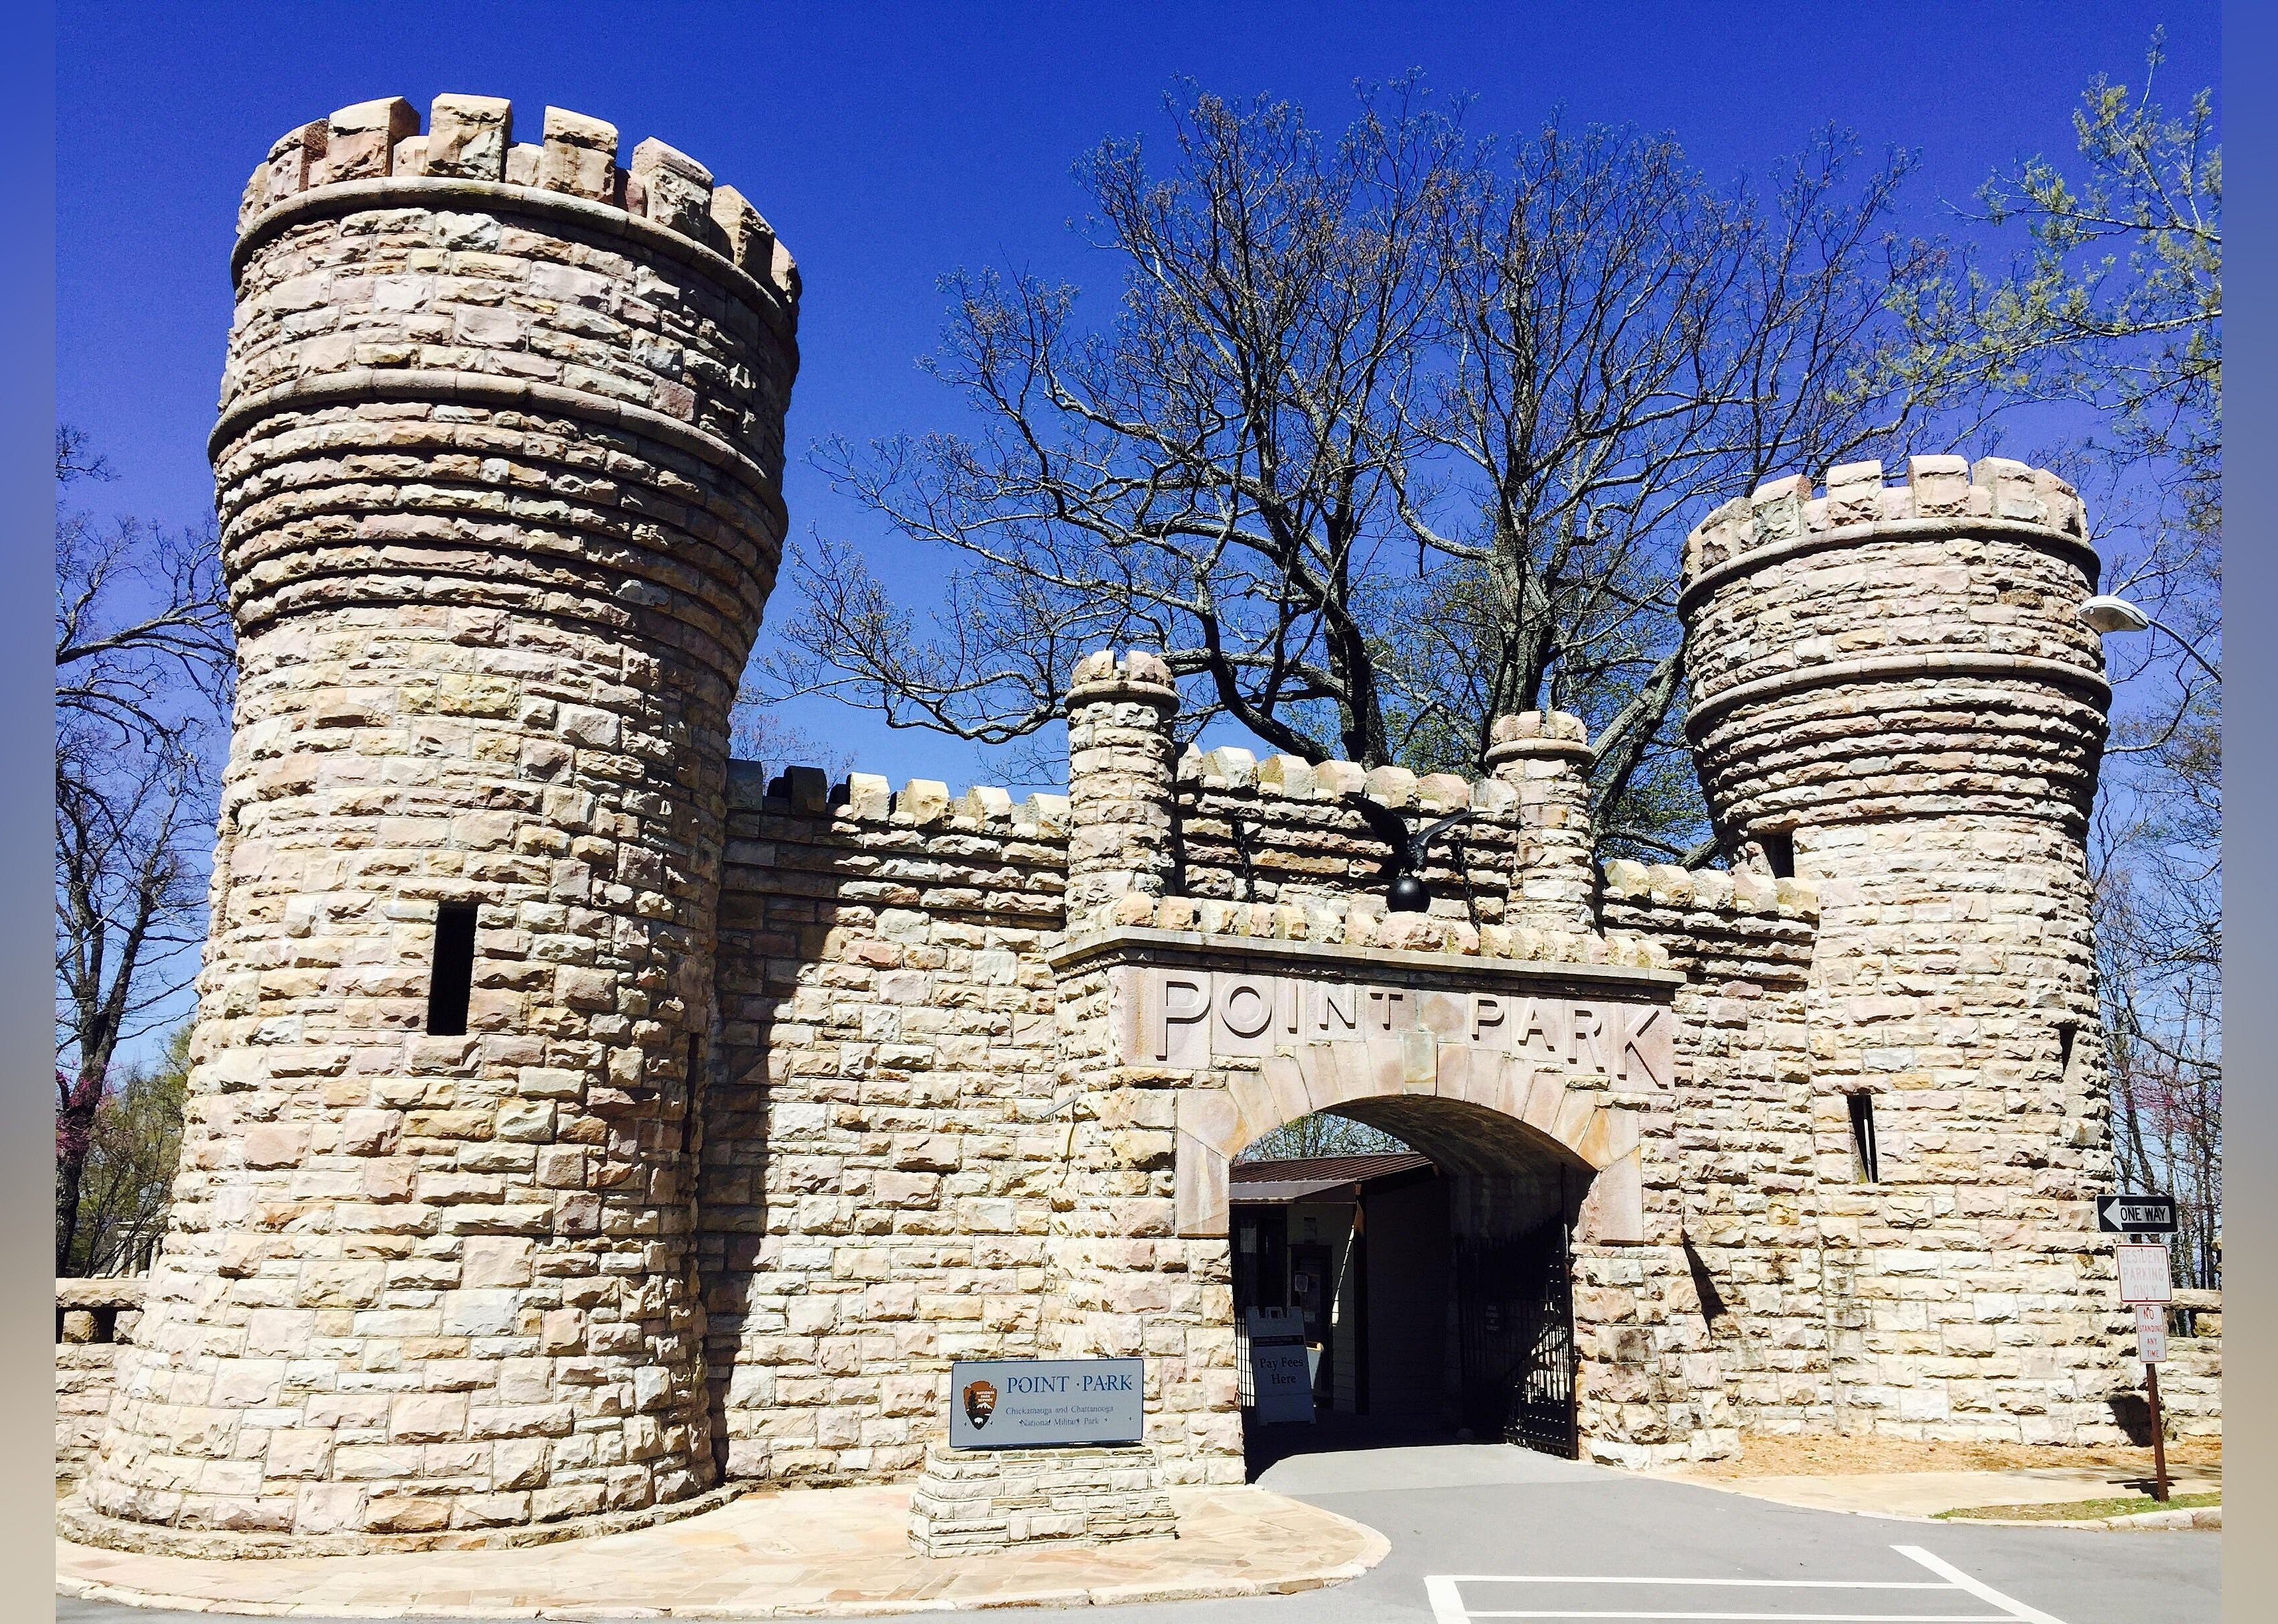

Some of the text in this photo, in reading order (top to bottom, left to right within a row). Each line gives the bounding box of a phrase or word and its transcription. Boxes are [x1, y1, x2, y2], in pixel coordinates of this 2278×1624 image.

[1156, 973, 1670, 1090] POINT PARK
[2120, 1206, 2167, 1221] ONE WAY
[2119, 1250, 2165, 1264] RESIDENT
[2123, 1267, 2164, 1282] PARKING
[2133, 1284, 2157, 1298] ONLY
[2143, 1308, 2155, 1320] NO
[2147, 1349, 2160, 1358] TIME
[1259, 1357, 1304, 1371] Pay Fees
[1006, 1374, 1133, 1394] POINT PARK
[1271, 1373, 1297, 1385] Here
[1005, 1406, 1052, 1416] Chickamauga
[1071, 1405, 1114, 1414] Chattanooga
[1021, 1418, 1051, 1427] National
[1084, 1416, 1100, 1425] Park
